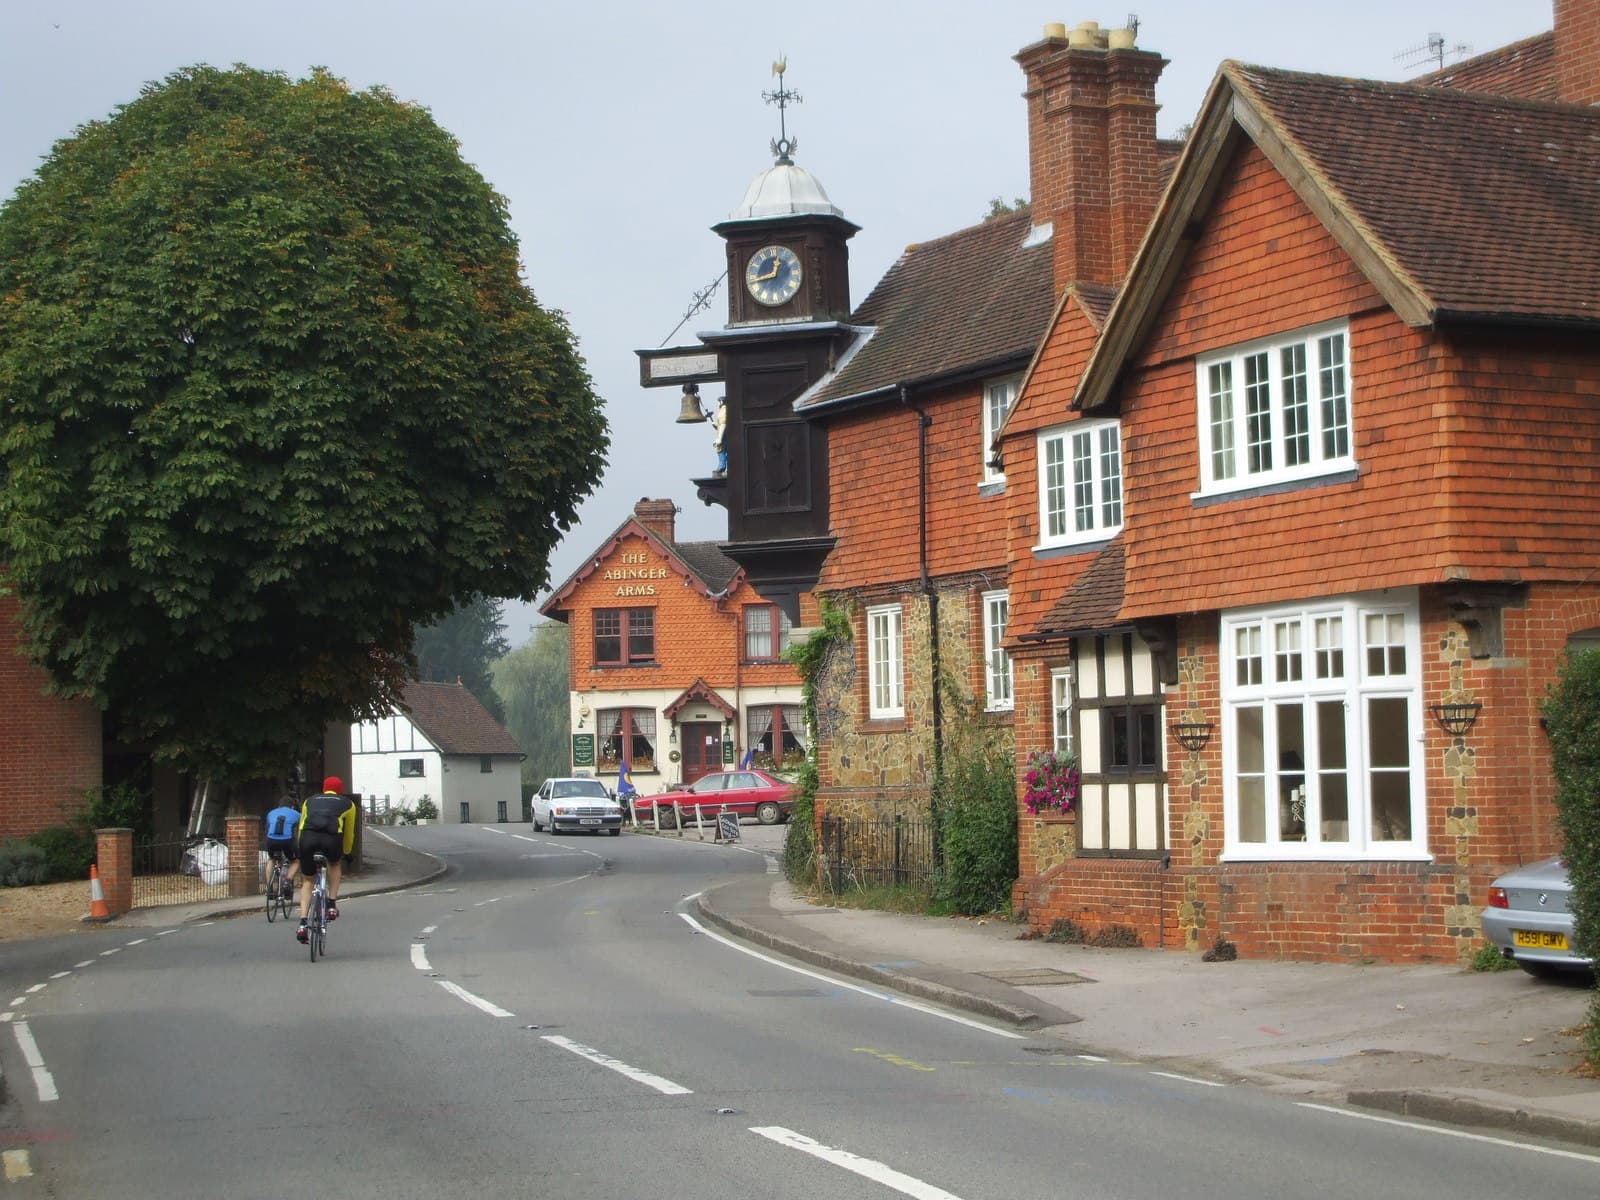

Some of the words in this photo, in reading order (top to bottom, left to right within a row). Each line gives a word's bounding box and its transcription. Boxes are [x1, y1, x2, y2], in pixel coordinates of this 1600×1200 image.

[621, 553, 648, 564] THE
[603, 568, 667, 580] ABINGER
[615, 585, 655, 597] ARMS
[1518, 931, 1541, 945] R591
